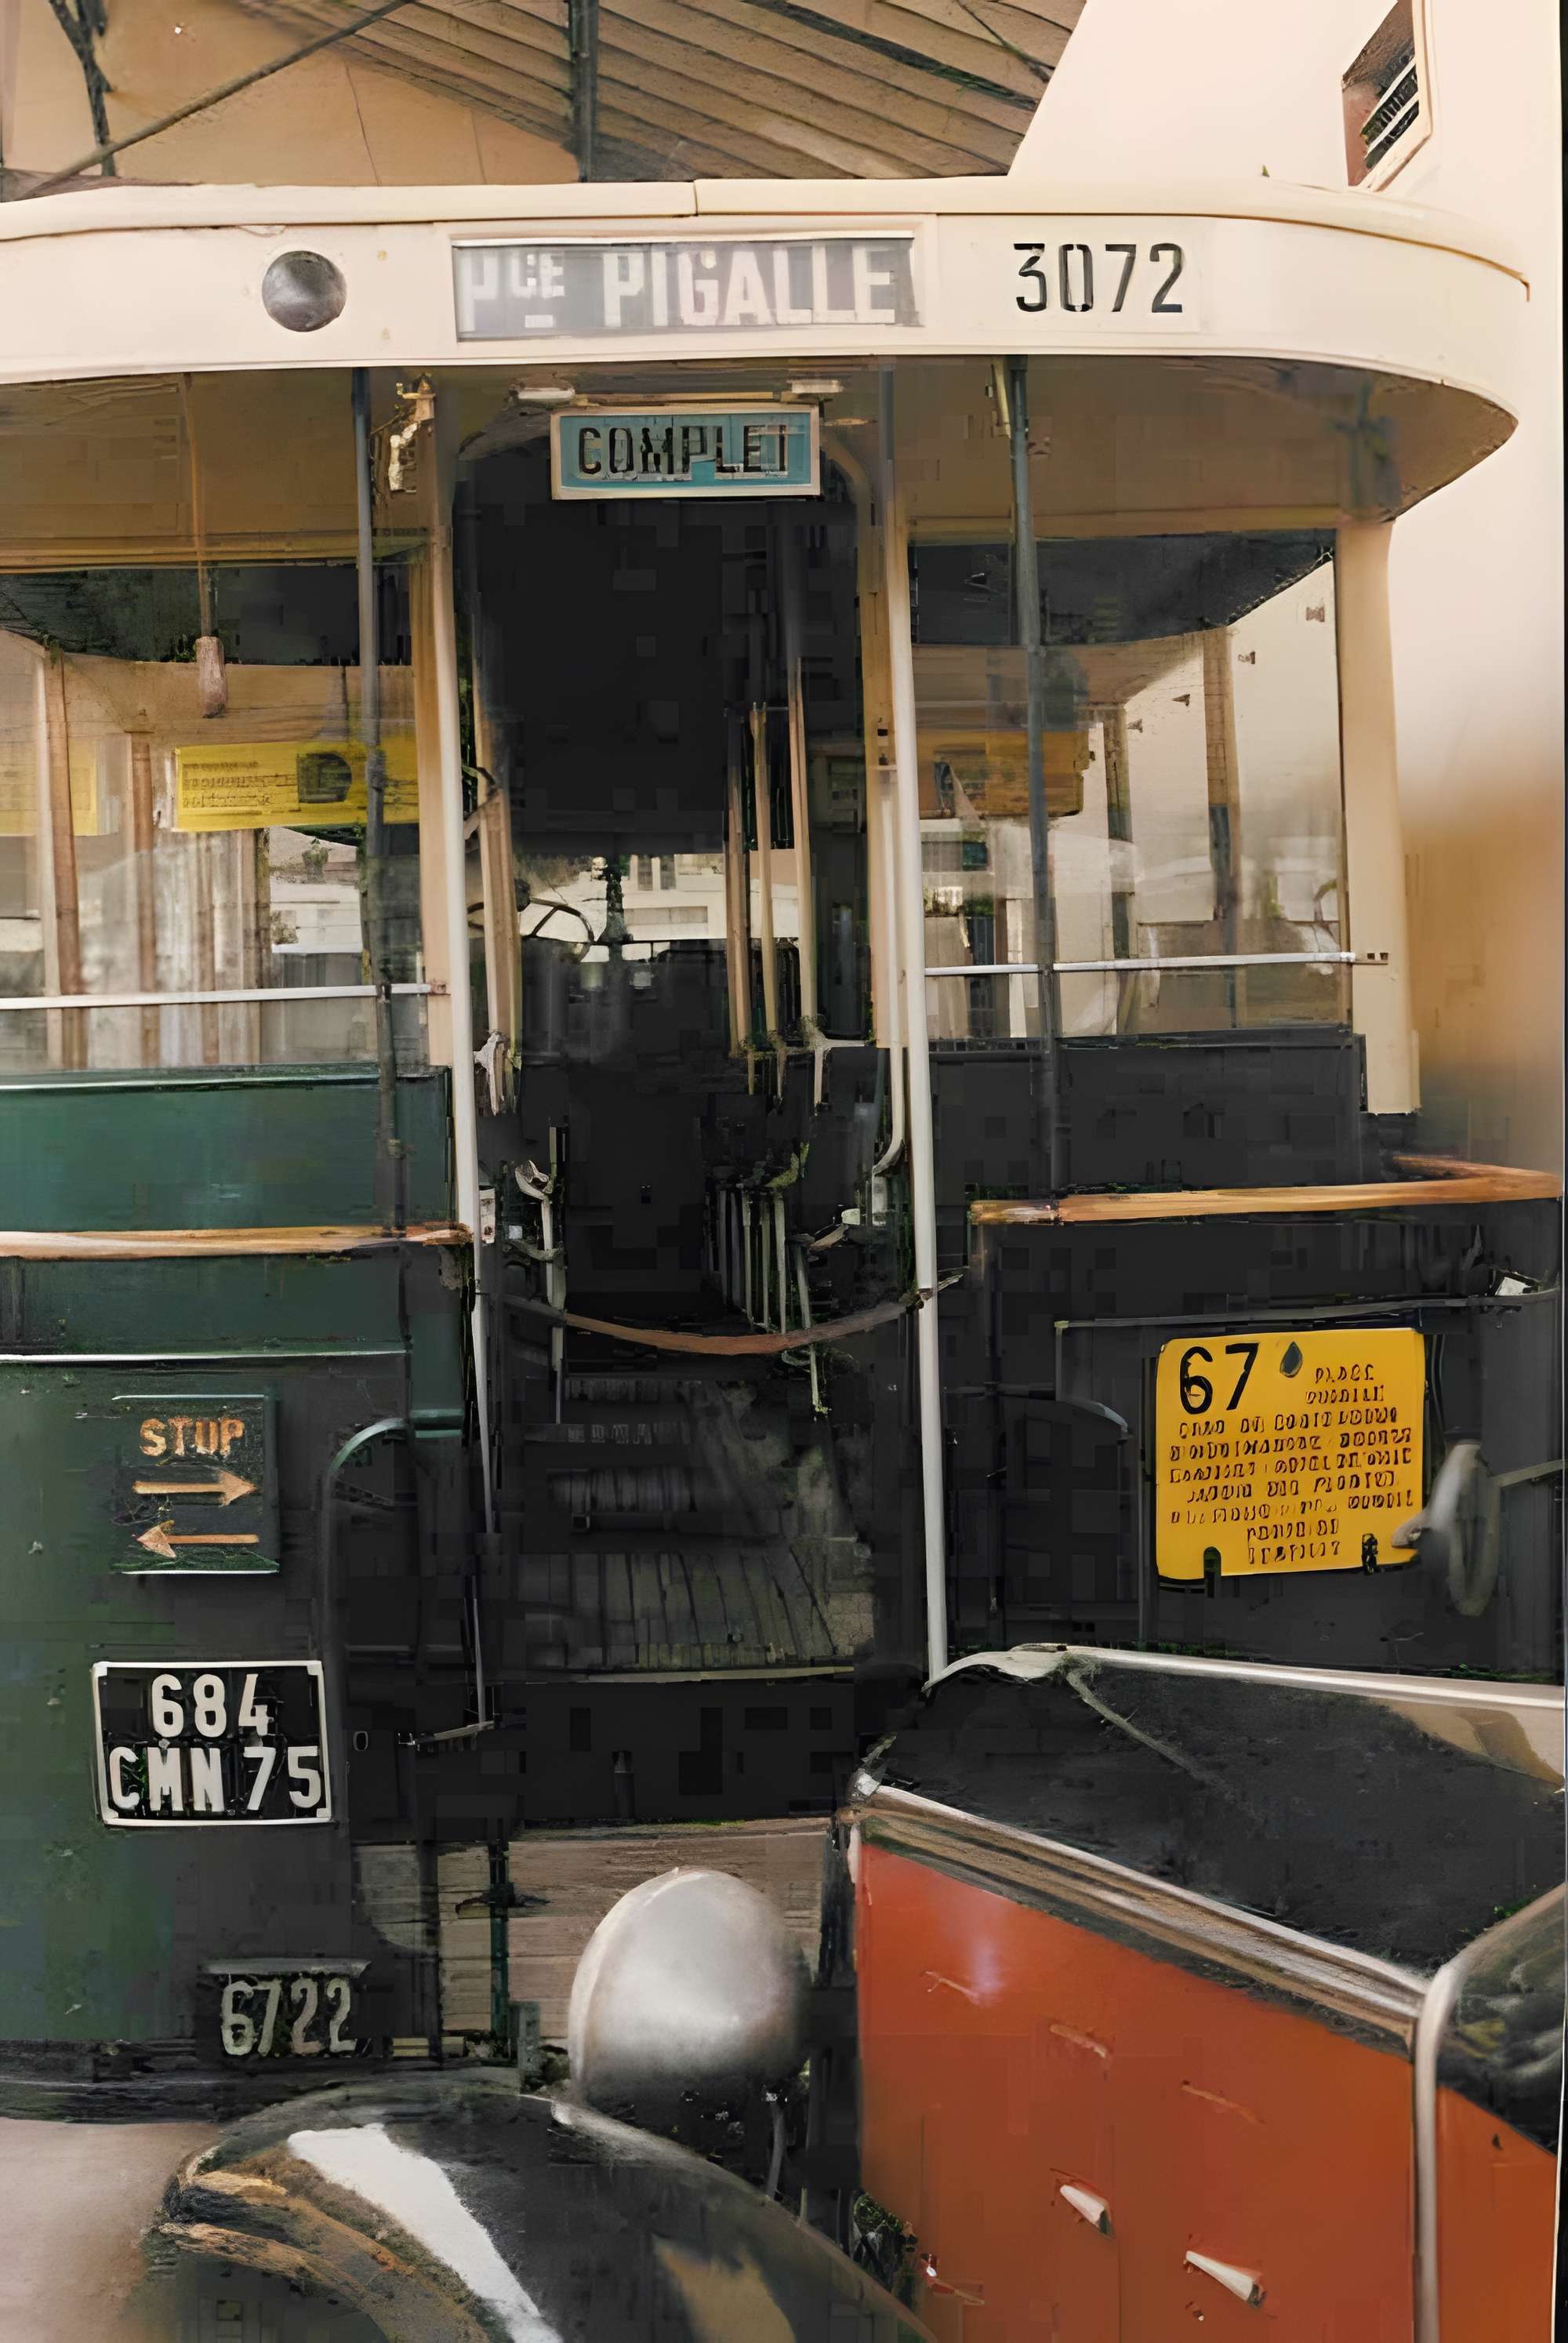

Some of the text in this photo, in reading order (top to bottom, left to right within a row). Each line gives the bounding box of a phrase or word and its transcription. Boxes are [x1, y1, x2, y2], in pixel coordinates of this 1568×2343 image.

[603, 243, 896, 326] PIGALLE
[1014, 242, 1183, 313] 3072
[1180, 1342, 1259, 1415] 67
[152, 1673, 269, 1738] 684
[110, 1745, 321, 1812] CMN 75
[221, 1978, 357, 2057] 6722
